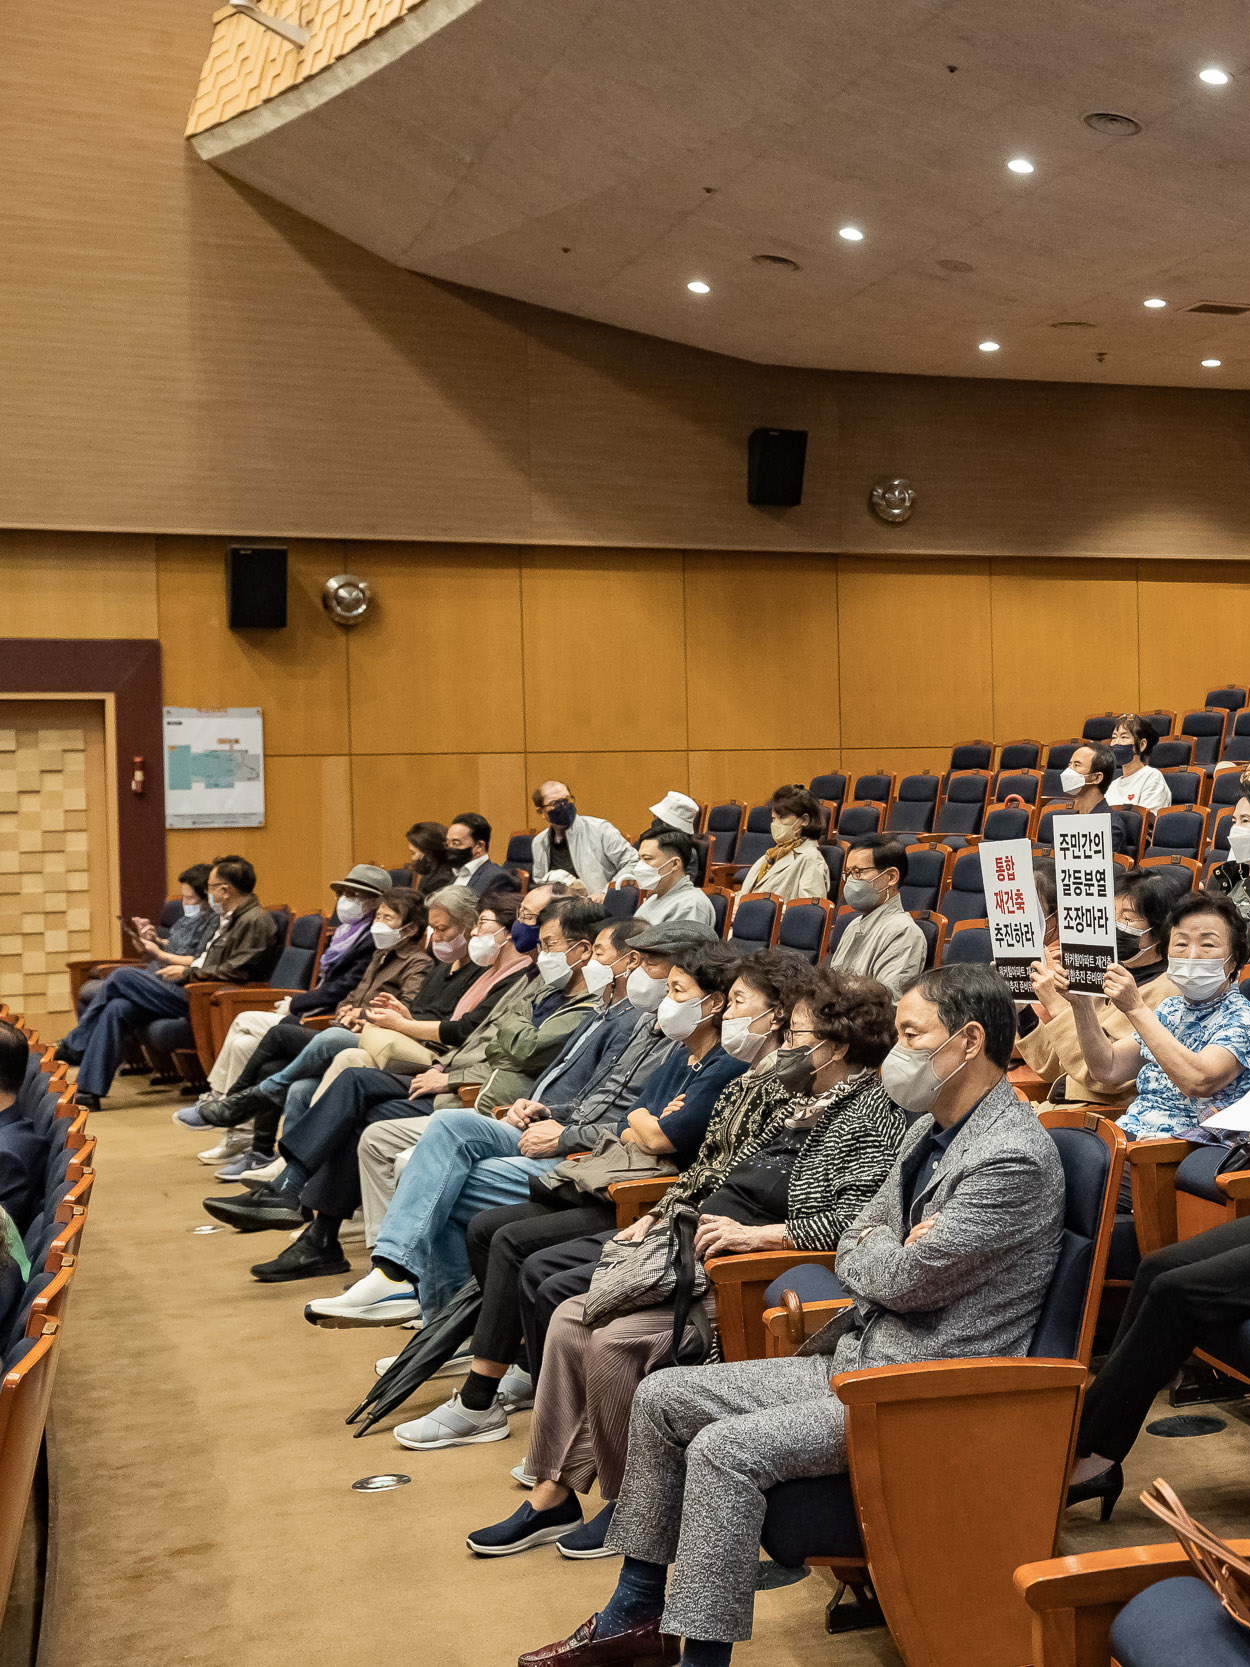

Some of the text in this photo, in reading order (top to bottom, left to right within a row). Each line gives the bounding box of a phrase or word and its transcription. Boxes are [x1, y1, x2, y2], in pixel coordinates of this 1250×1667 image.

[1059, 830, 1105, 860] 주민간의
[995, 855, 1016, 882] 통합
[1061, 868, 1108, 898] 갈등분열
[993, 888, 1026, 915] 재건축
[1063, 905, 1109, 936] 조장마라
[994, 921, 1035, 948] 추진하라
[1064, 952, 1095, 968] 워커힐아파트
